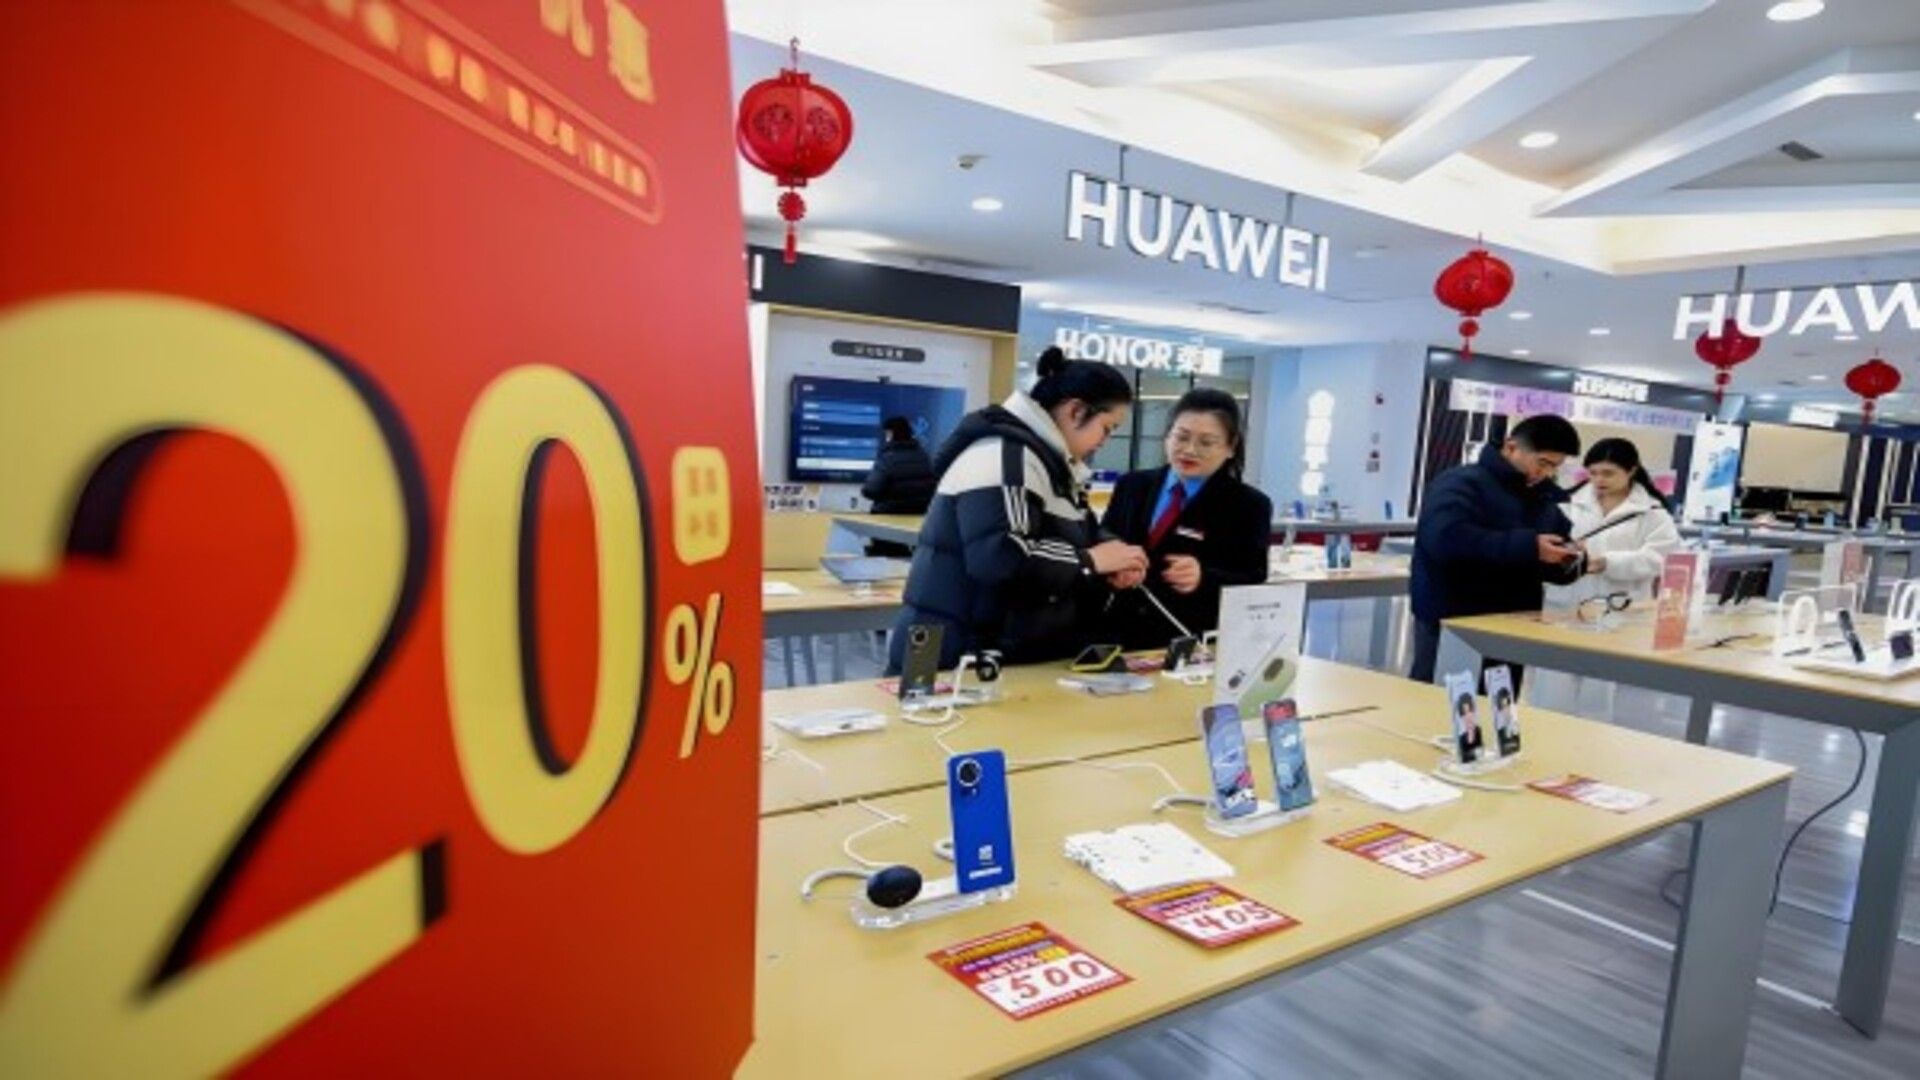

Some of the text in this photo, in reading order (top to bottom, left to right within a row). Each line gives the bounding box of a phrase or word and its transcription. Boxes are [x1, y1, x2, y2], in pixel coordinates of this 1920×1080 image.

[1067, 171, 1329, 291] HUAWEI
[1055, 327, 1172, 370] HONOR
[1192, 904, 1271, 931] 405
[1010, 960, 1101, 999] 500
